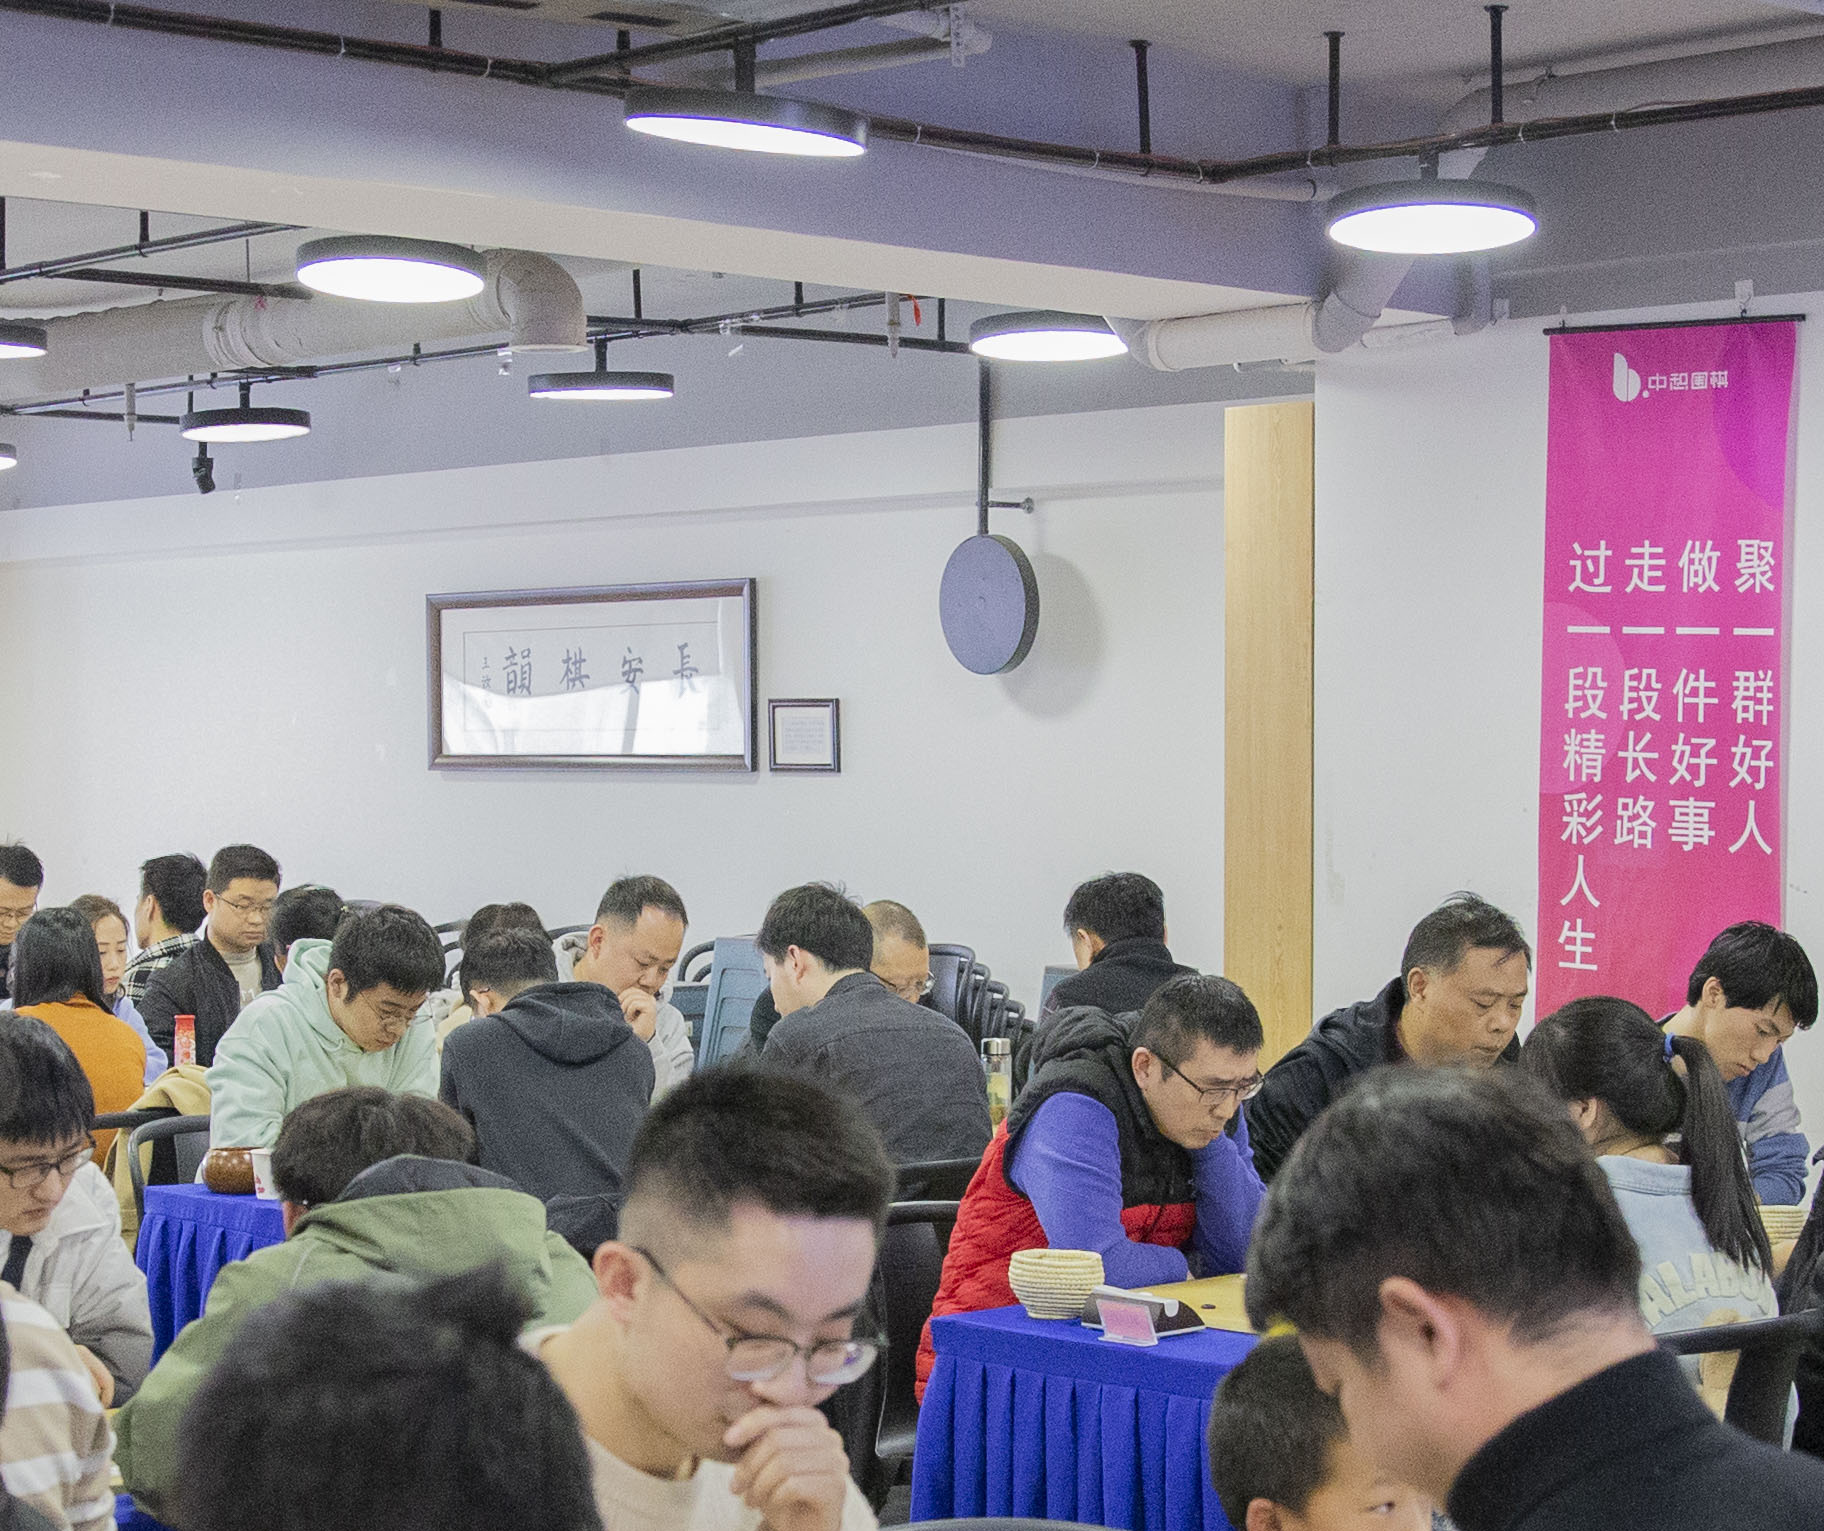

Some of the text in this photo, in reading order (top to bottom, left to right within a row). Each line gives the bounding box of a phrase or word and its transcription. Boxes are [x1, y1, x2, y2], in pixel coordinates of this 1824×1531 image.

[1557, 540, 1614, 972] 过一段精彩人生
[1613, 540, 1666, 850] 走一段长路
[1667, 539, 1721, 852] 做一件好事
[1728, 539, 1776, 855] 聚一群好人
